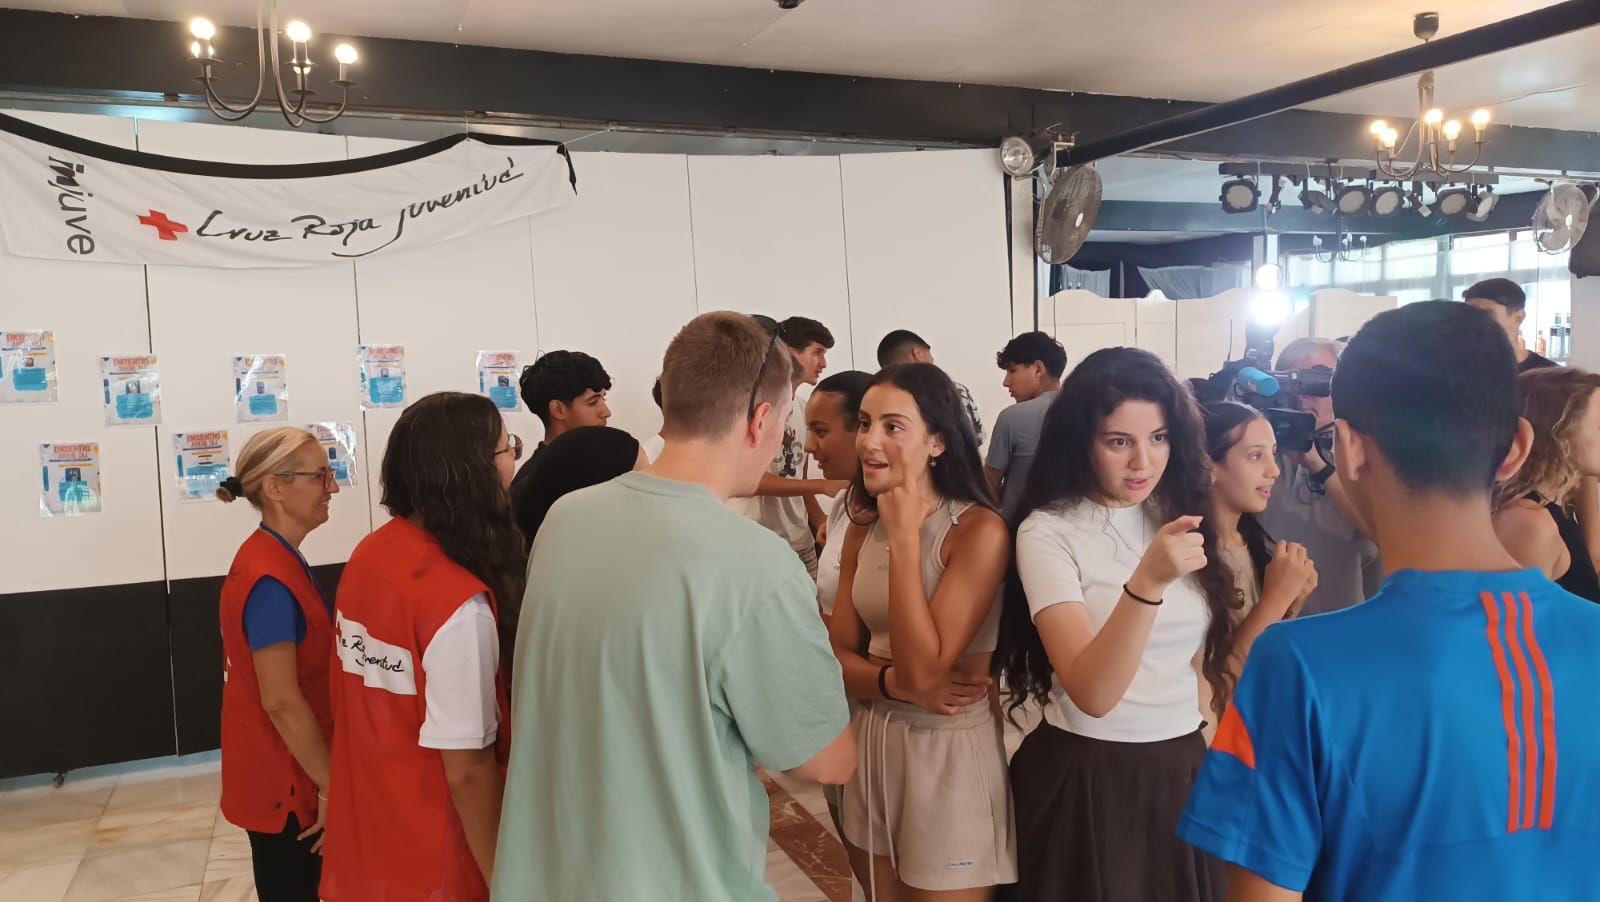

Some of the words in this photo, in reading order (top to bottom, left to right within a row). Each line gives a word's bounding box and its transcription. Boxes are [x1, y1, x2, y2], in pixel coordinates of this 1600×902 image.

[47, 155, 96, 255] injuve
[196, 210, 292, 242] Cruz
[290, 215, 381, 247] Roja
